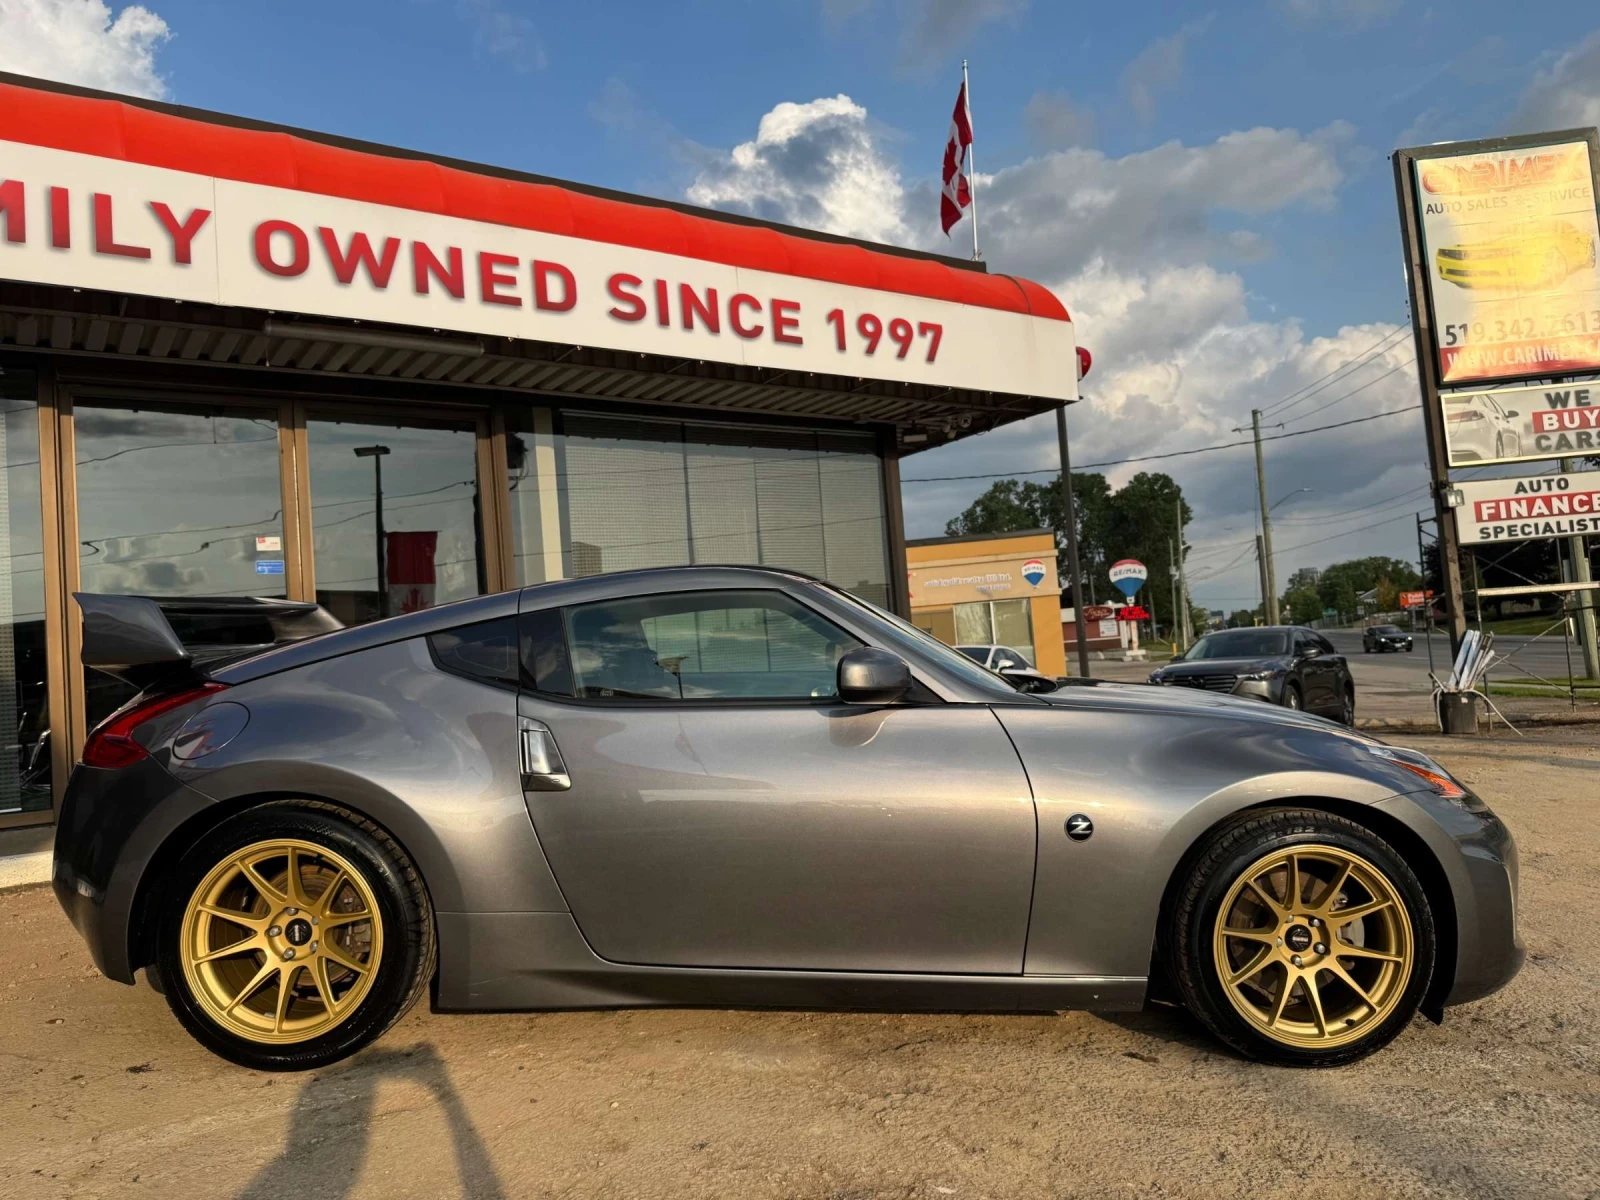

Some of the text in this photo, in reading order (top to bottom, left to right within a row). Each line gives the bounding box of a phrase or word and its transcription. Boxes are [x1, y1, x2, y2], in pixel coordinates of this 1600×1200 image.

[1422, 154, 1587, 195] CARIME
[1426, 202, 1462, 215] AUTO
[1467, 195, 1508, 212] SALES
[1534, 187, 1591, 203] SERVICE
[254, 219, 578, 313] OWNED
[607, 272, 803, 345] SINCE
[827, 308, 943, 363] 1997
[1544, 389, 1591, 409] WE
[1542, 408, 1600, 431] BUY
[1514, 477, 1569, 495] AUTO
[1480, 493, 1600, 521] FINANCE
[1479, 517, 1600, 540] SPECIALIST
[1113, 568, 1143, 577] RE/MAX
